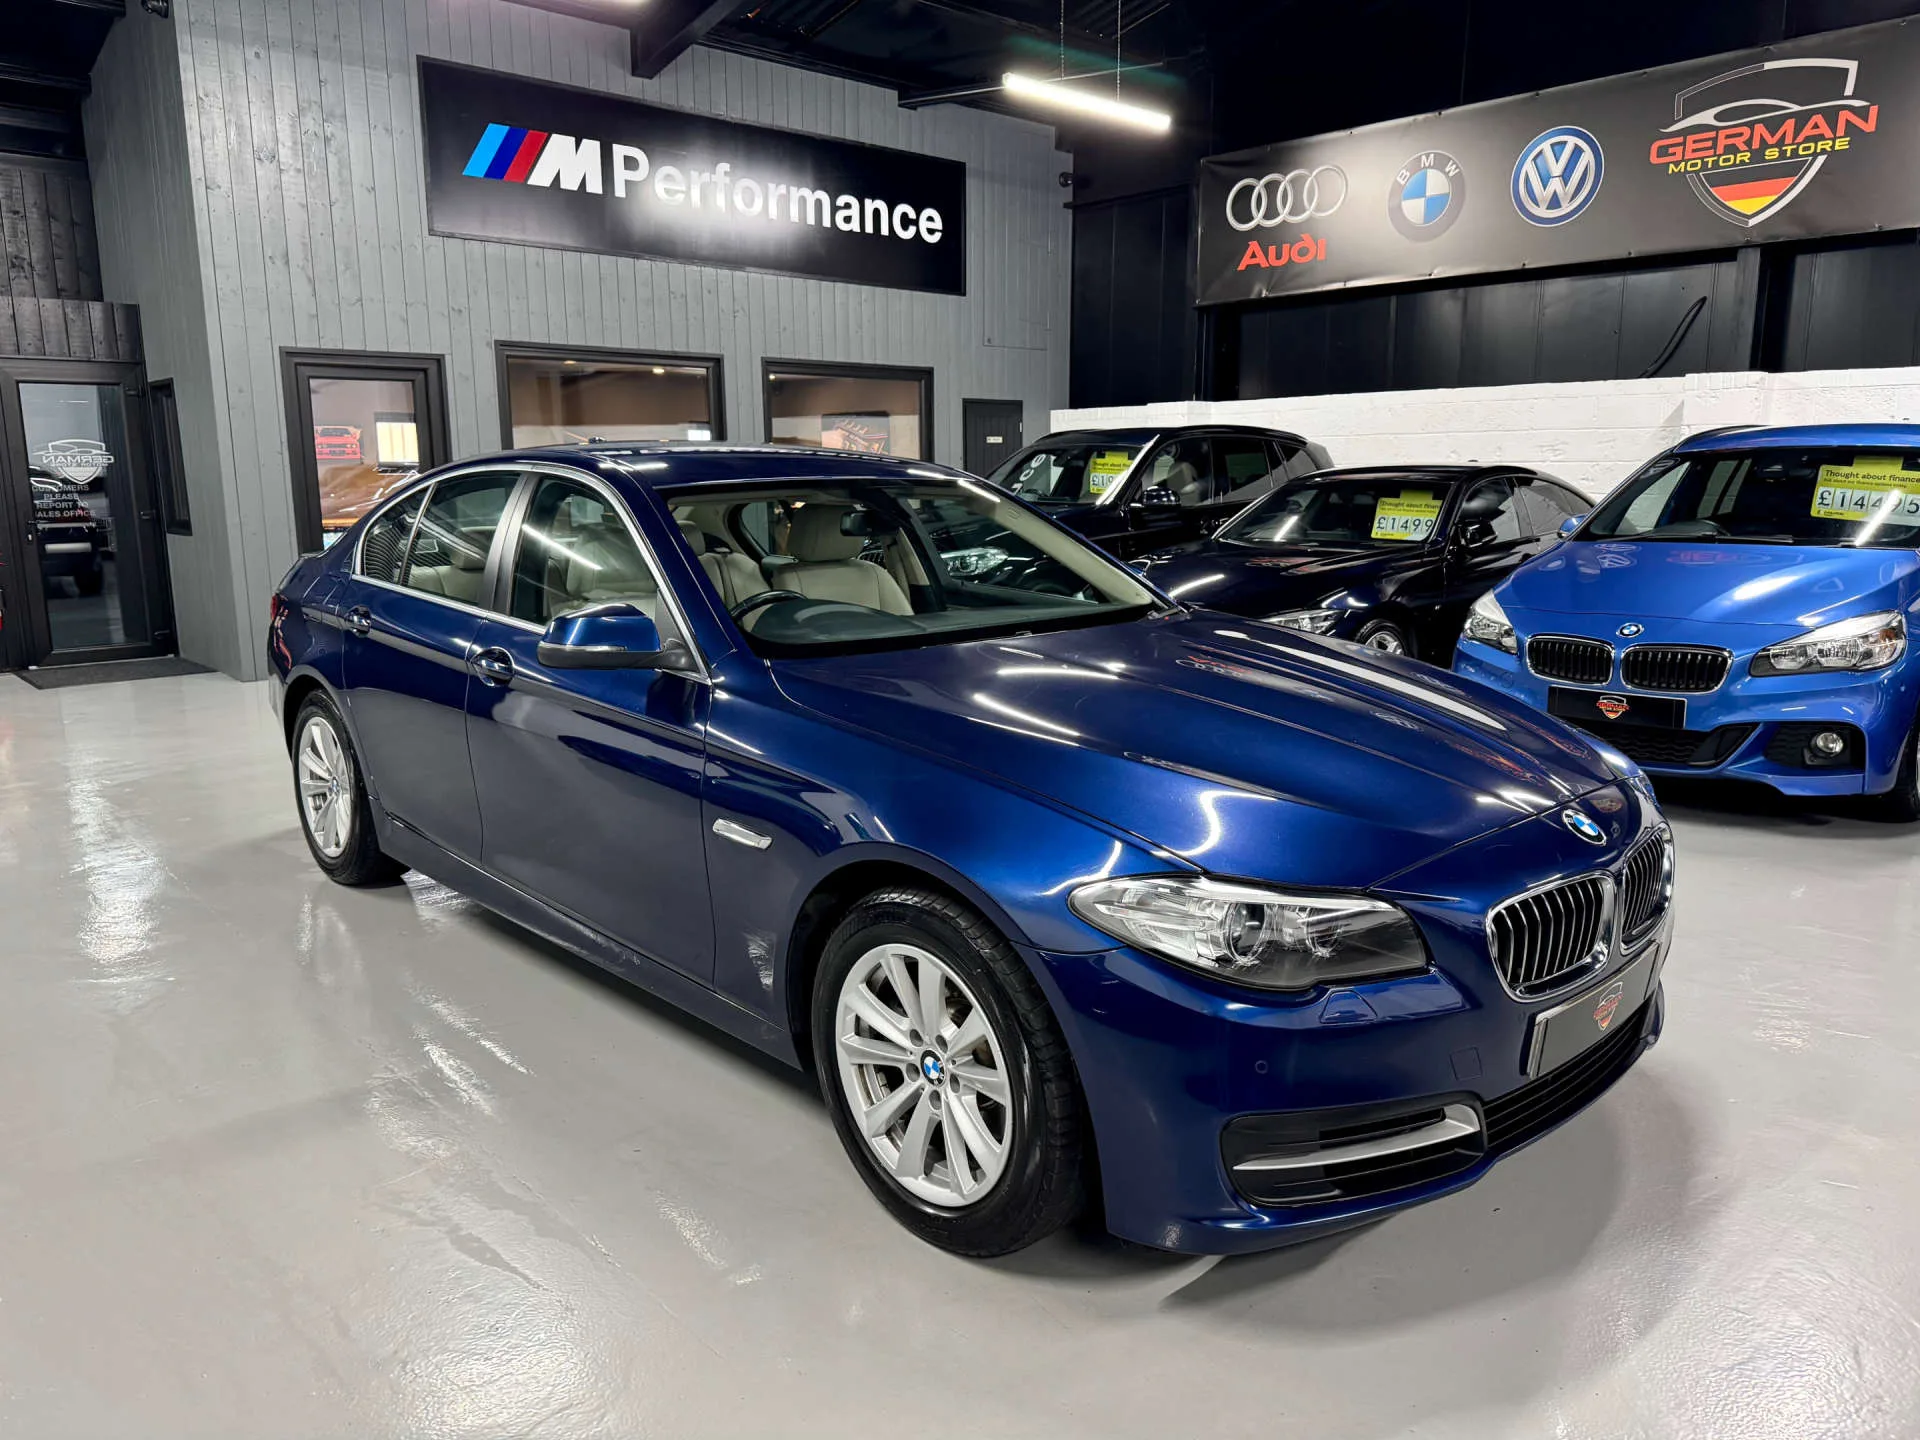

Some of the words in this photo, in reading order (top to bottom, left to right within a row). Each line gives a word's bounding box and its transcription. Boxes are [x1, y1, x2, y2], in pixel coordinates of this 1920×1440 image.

[1650, 105, 1879, 164] GERMAN
[1396, 153, 1460, 185] BMW
[1668, 152, 1751, 174] MOTOR
[1764, 137, 1851, 160] STORE
[612, 143, 943, 244] Performance
[1237, 233, 1326, 271] Audi
[1825, 469, 1860, 479] Thought
